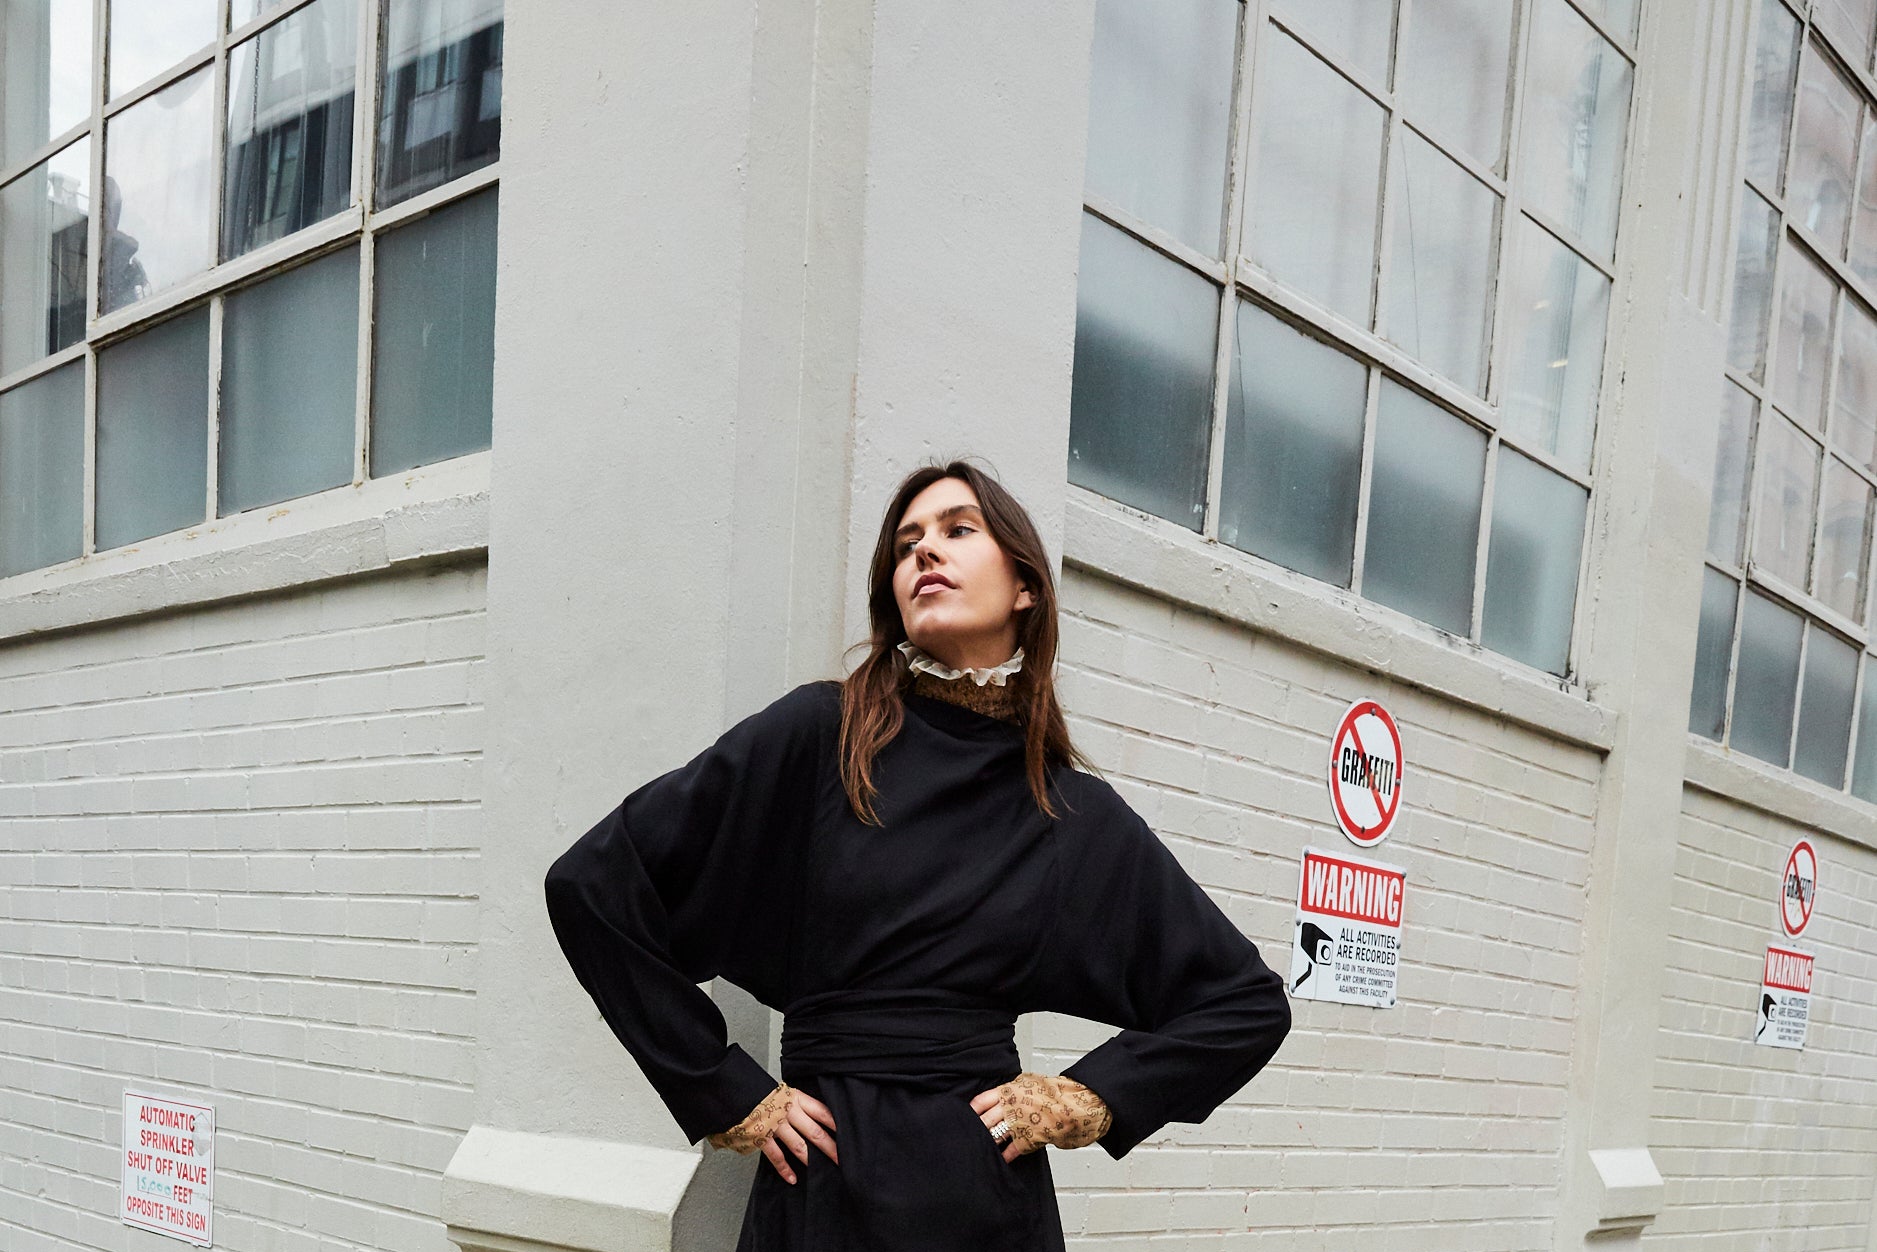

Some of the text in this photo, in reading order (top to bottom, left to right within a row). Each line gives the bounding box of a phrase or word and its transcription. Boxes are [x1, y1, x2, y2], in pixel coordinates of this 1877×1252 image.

[1341, 747, 1394, 796] GRAFFITI
[1307, 859, 1400, 922] WARNING
[1340, 928, 1396, 949] ALL ACTIVITIES
[1337, 944, 1396, 965] ARE RECORDED
[1335, 962, 1396, 978] TO AID IN THE PROSECUTION
[1335, 973, 1393, 988] OF ANY CRIME COMMITTED
[1766, 951, 1811, 990] WARNING
[1339, 985, 1388, 998] AGAINST THIS FACILITY
[140, 1105, 195, 1132] AUTOMATIC
[140, 1130, 194, 1157] SPRINKLER
[128, 1150, 207, 1185] SHUT OFF VALVE
[173, 1185, 193, 1205] FEET
[127, 1195, 206, 1232] OPPOSITE THIS SIGN
